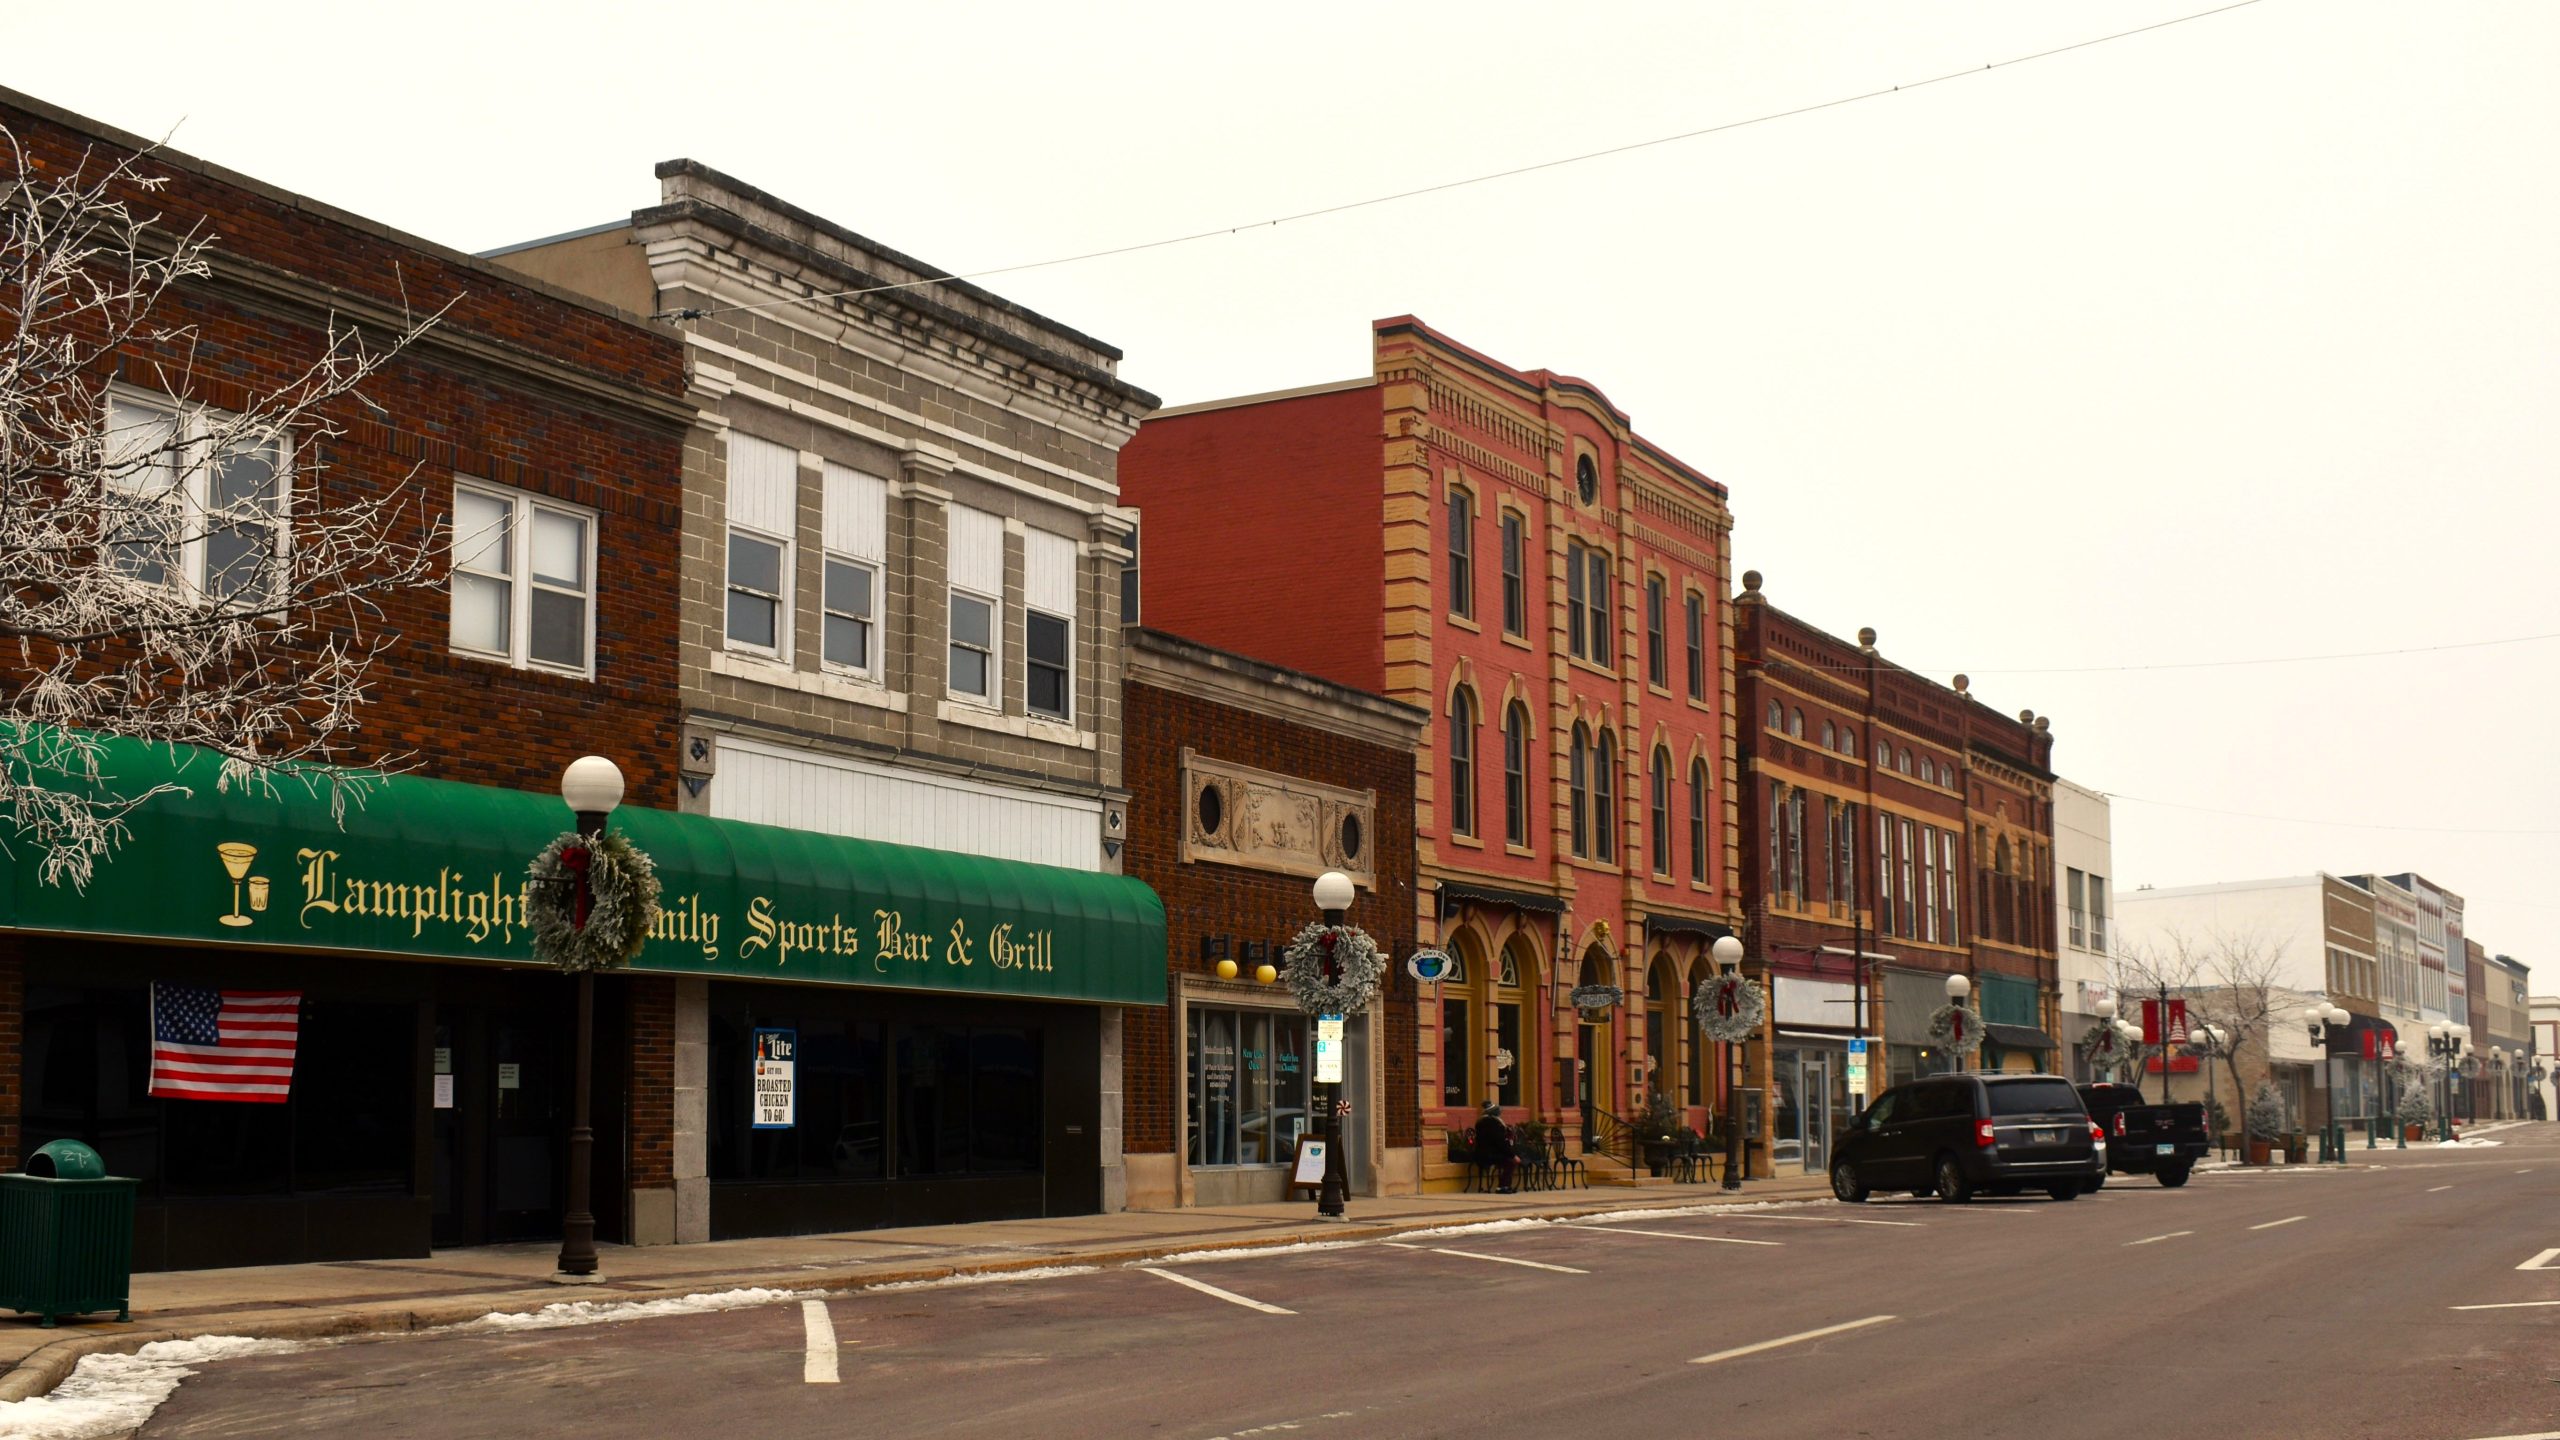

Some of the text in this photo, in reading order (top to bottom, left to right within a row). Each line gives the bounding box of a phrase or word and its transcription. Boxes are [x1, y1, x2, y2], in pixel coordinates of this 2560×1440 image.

[296, 847, 1053, 974] Lamplight mily Sports Bar & Grill
[767, 1039, 793, 1060] Lite
[767, 1067, 775, 1075] GET
[757, 1079, 792, 1092] BROASTED
[759, 1094, 789, 1107] CHICKEN
[763, 1109, 785, 1122] TO GO!
